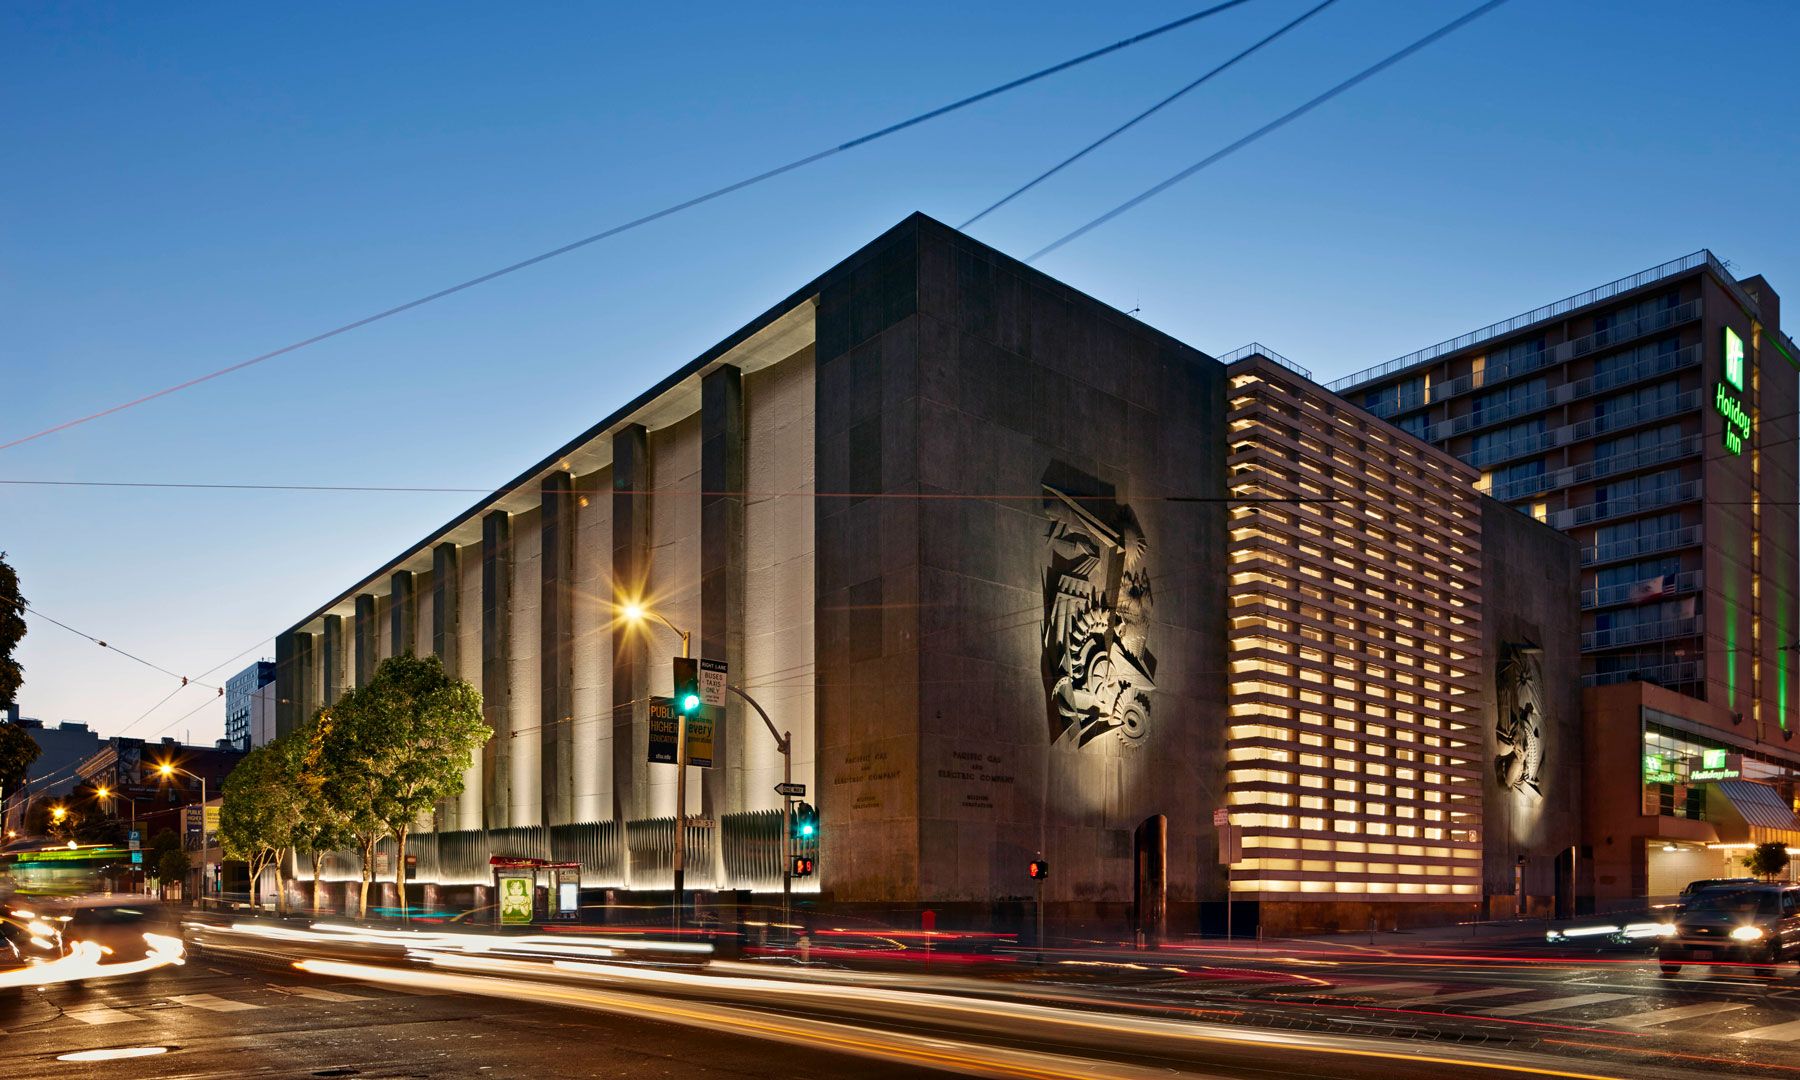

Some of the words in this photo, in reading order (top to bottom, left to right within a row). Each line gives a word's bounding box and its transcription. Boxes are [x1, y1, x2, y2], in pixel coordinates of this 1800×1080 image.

[1716, 382, 1751, 439] Holiday
[1726, 421, 1741, 456] Inn
[704, 672, 723, 680] BUSES
[688, 723, 712, 738] every
[938, 770, 975, 781] ELECTRIC
[979, 774, 1015, 785] COMPANY
[1690, 770, 1724, 780] Holiday
